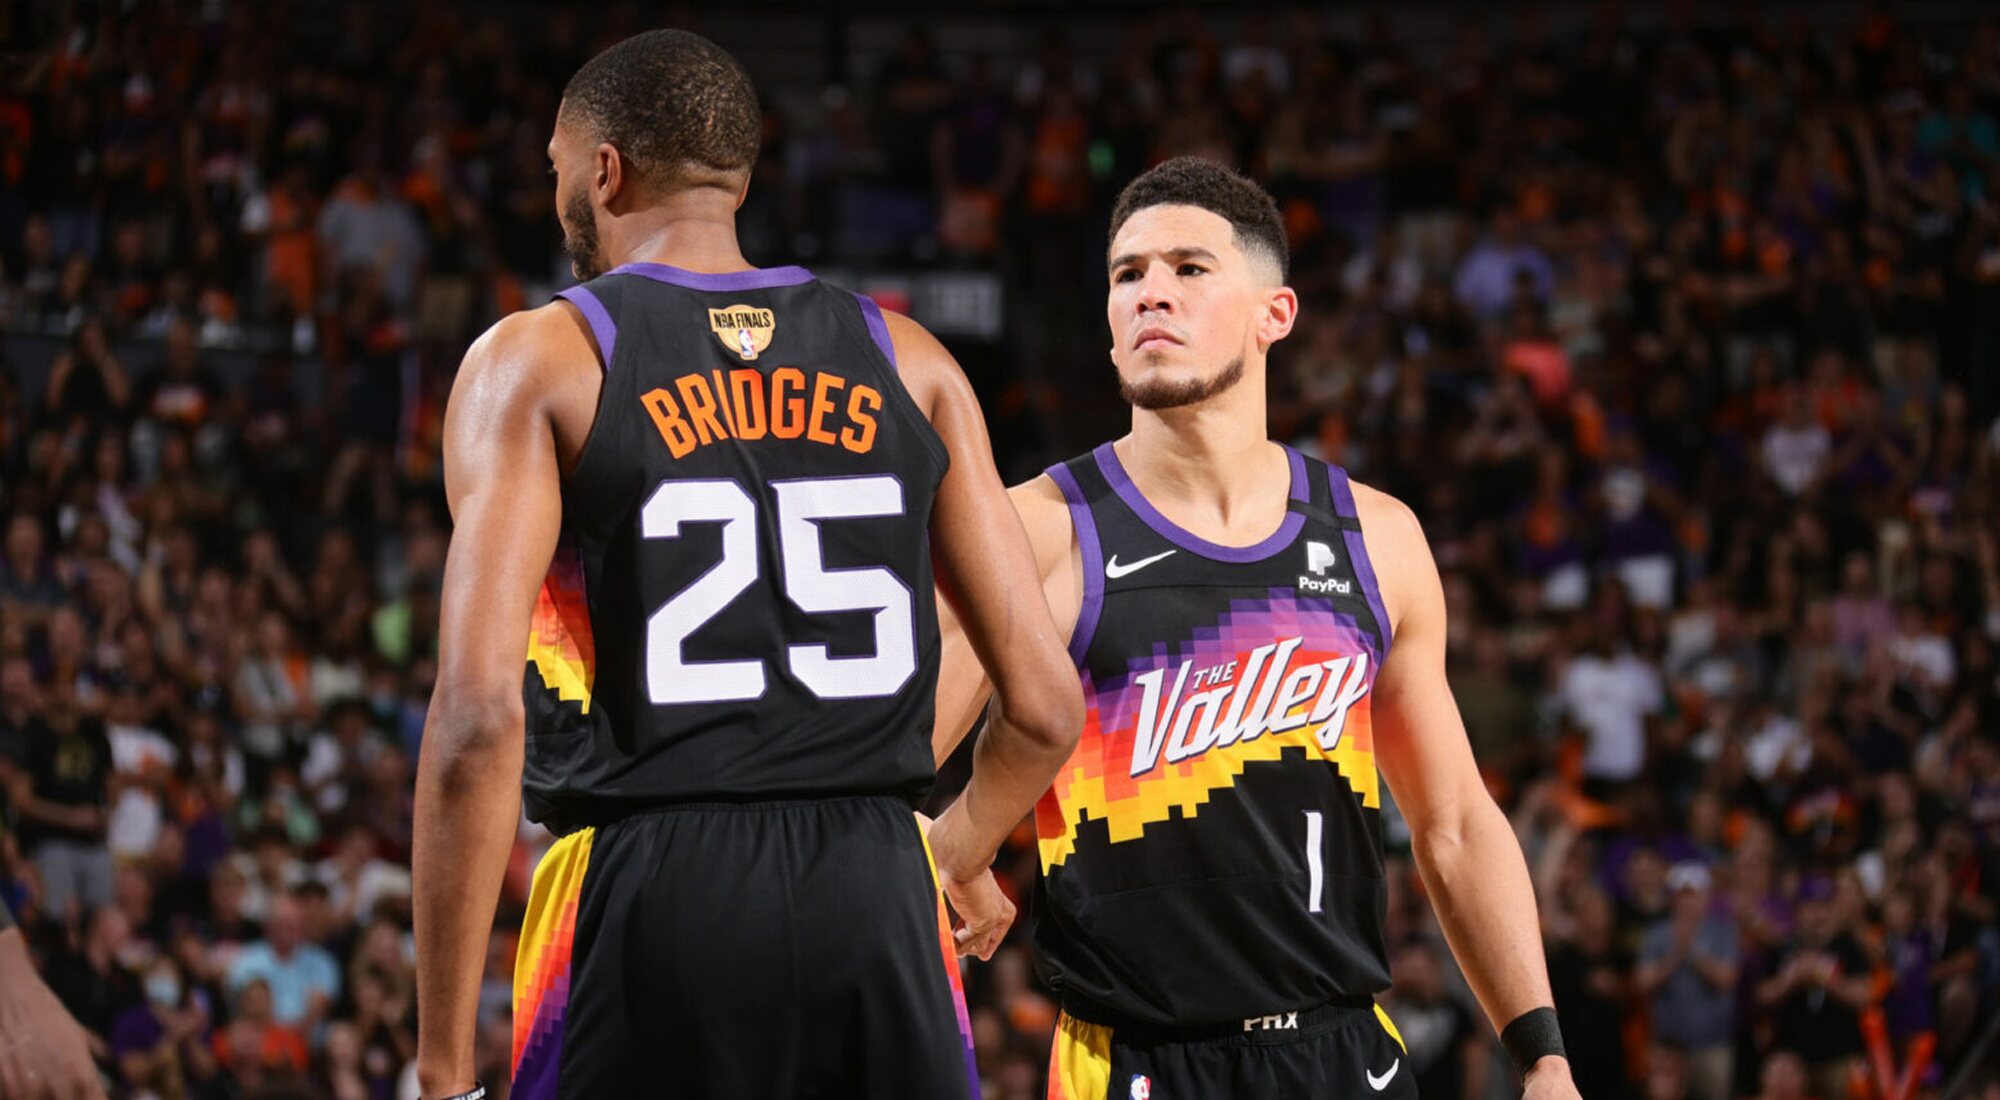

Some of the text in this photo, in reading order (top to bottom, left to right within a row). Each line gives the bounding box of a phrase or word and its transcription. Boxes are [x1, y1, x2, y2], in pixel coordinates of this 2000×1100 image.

[713, 311, 771, 328] NBA FINALS
[640, 367, 882, 459] BRIDGES
[641, 473, 918, 704] 25
[1299, 576, 1350, 594] PayPal
[1130, 636, 1369, 778] THE Valley
[1302, 810, 1323, 913] 1
